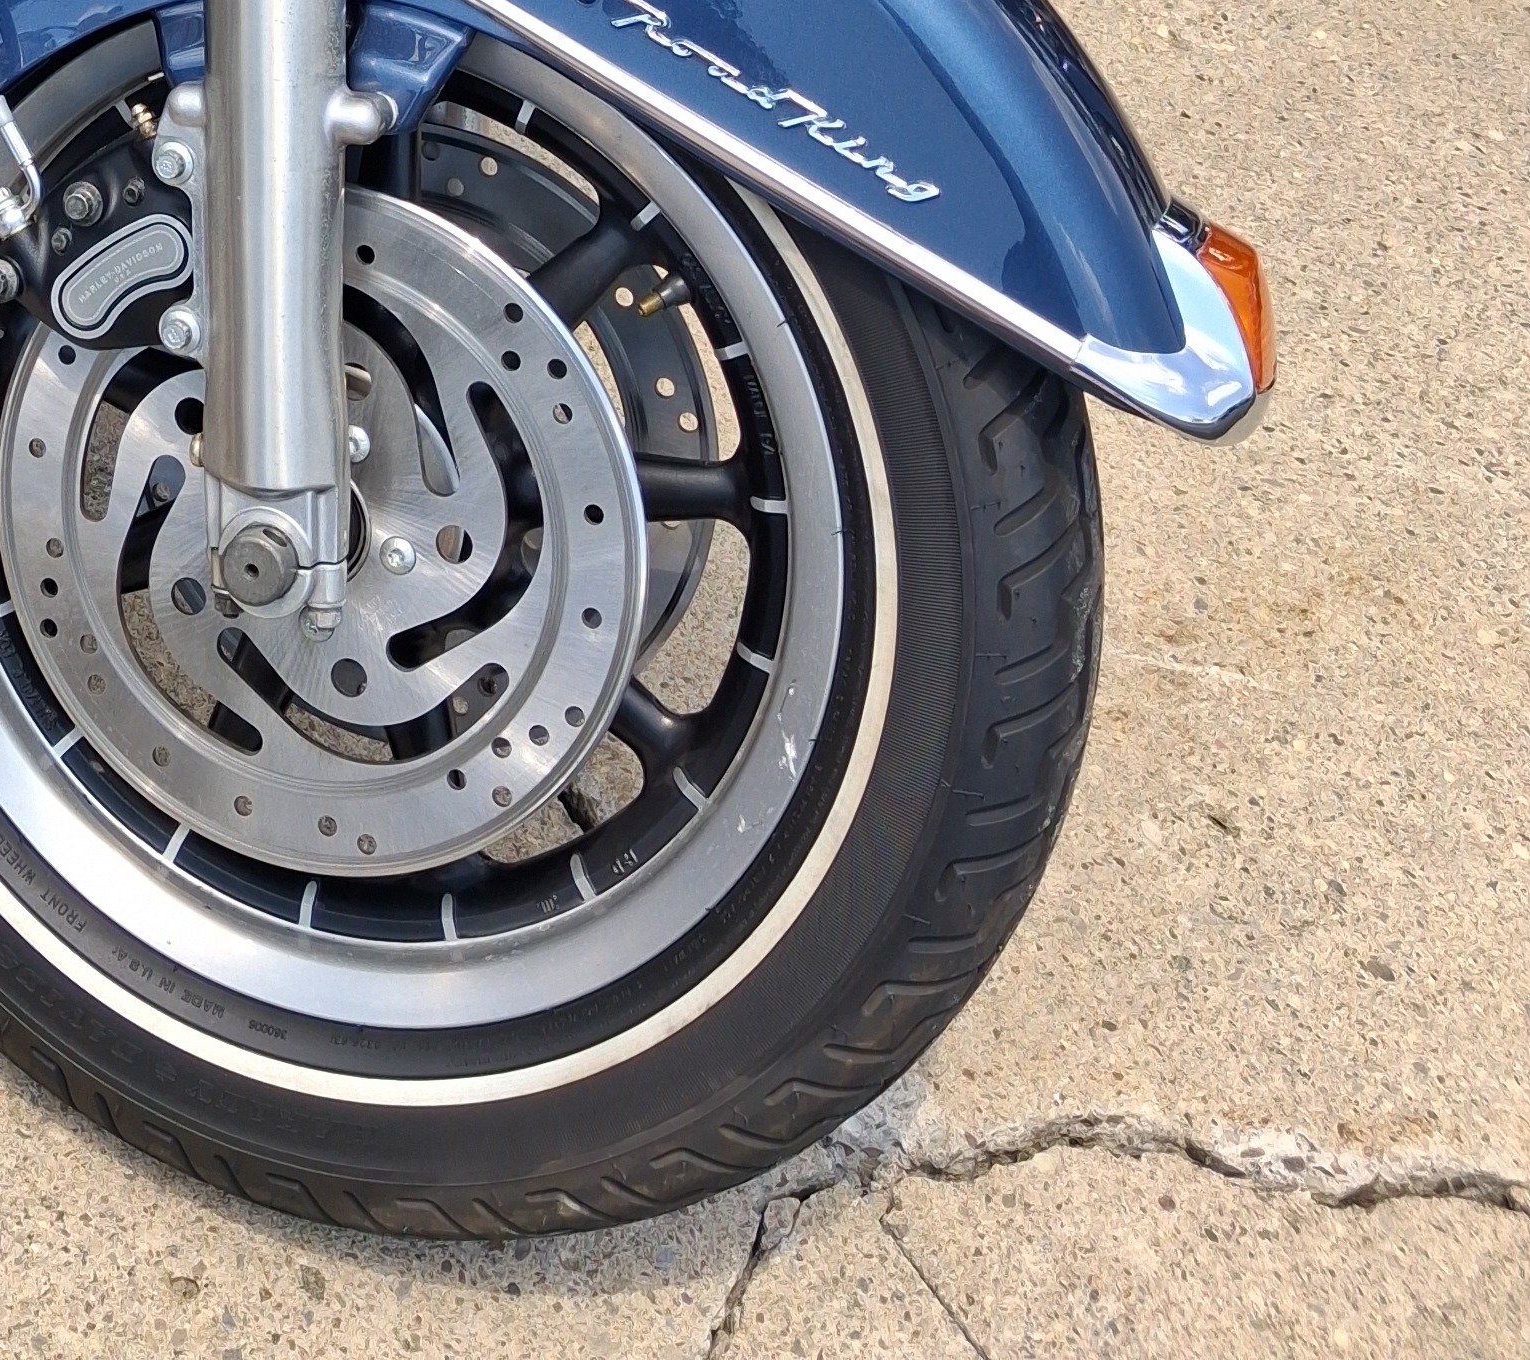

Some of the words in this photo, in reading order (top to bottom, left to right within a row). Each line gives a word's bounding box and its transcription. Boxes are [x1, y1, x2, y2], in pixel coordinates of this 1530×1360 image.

[773, 88, 941, 202] King
[78, 242, 164, 304] HARLEY-DAVIDSON
[40, 888, 88, 934] FRONT
[158, 976, 176, 995] IN
[180, 988, 227, 1020] MADE
